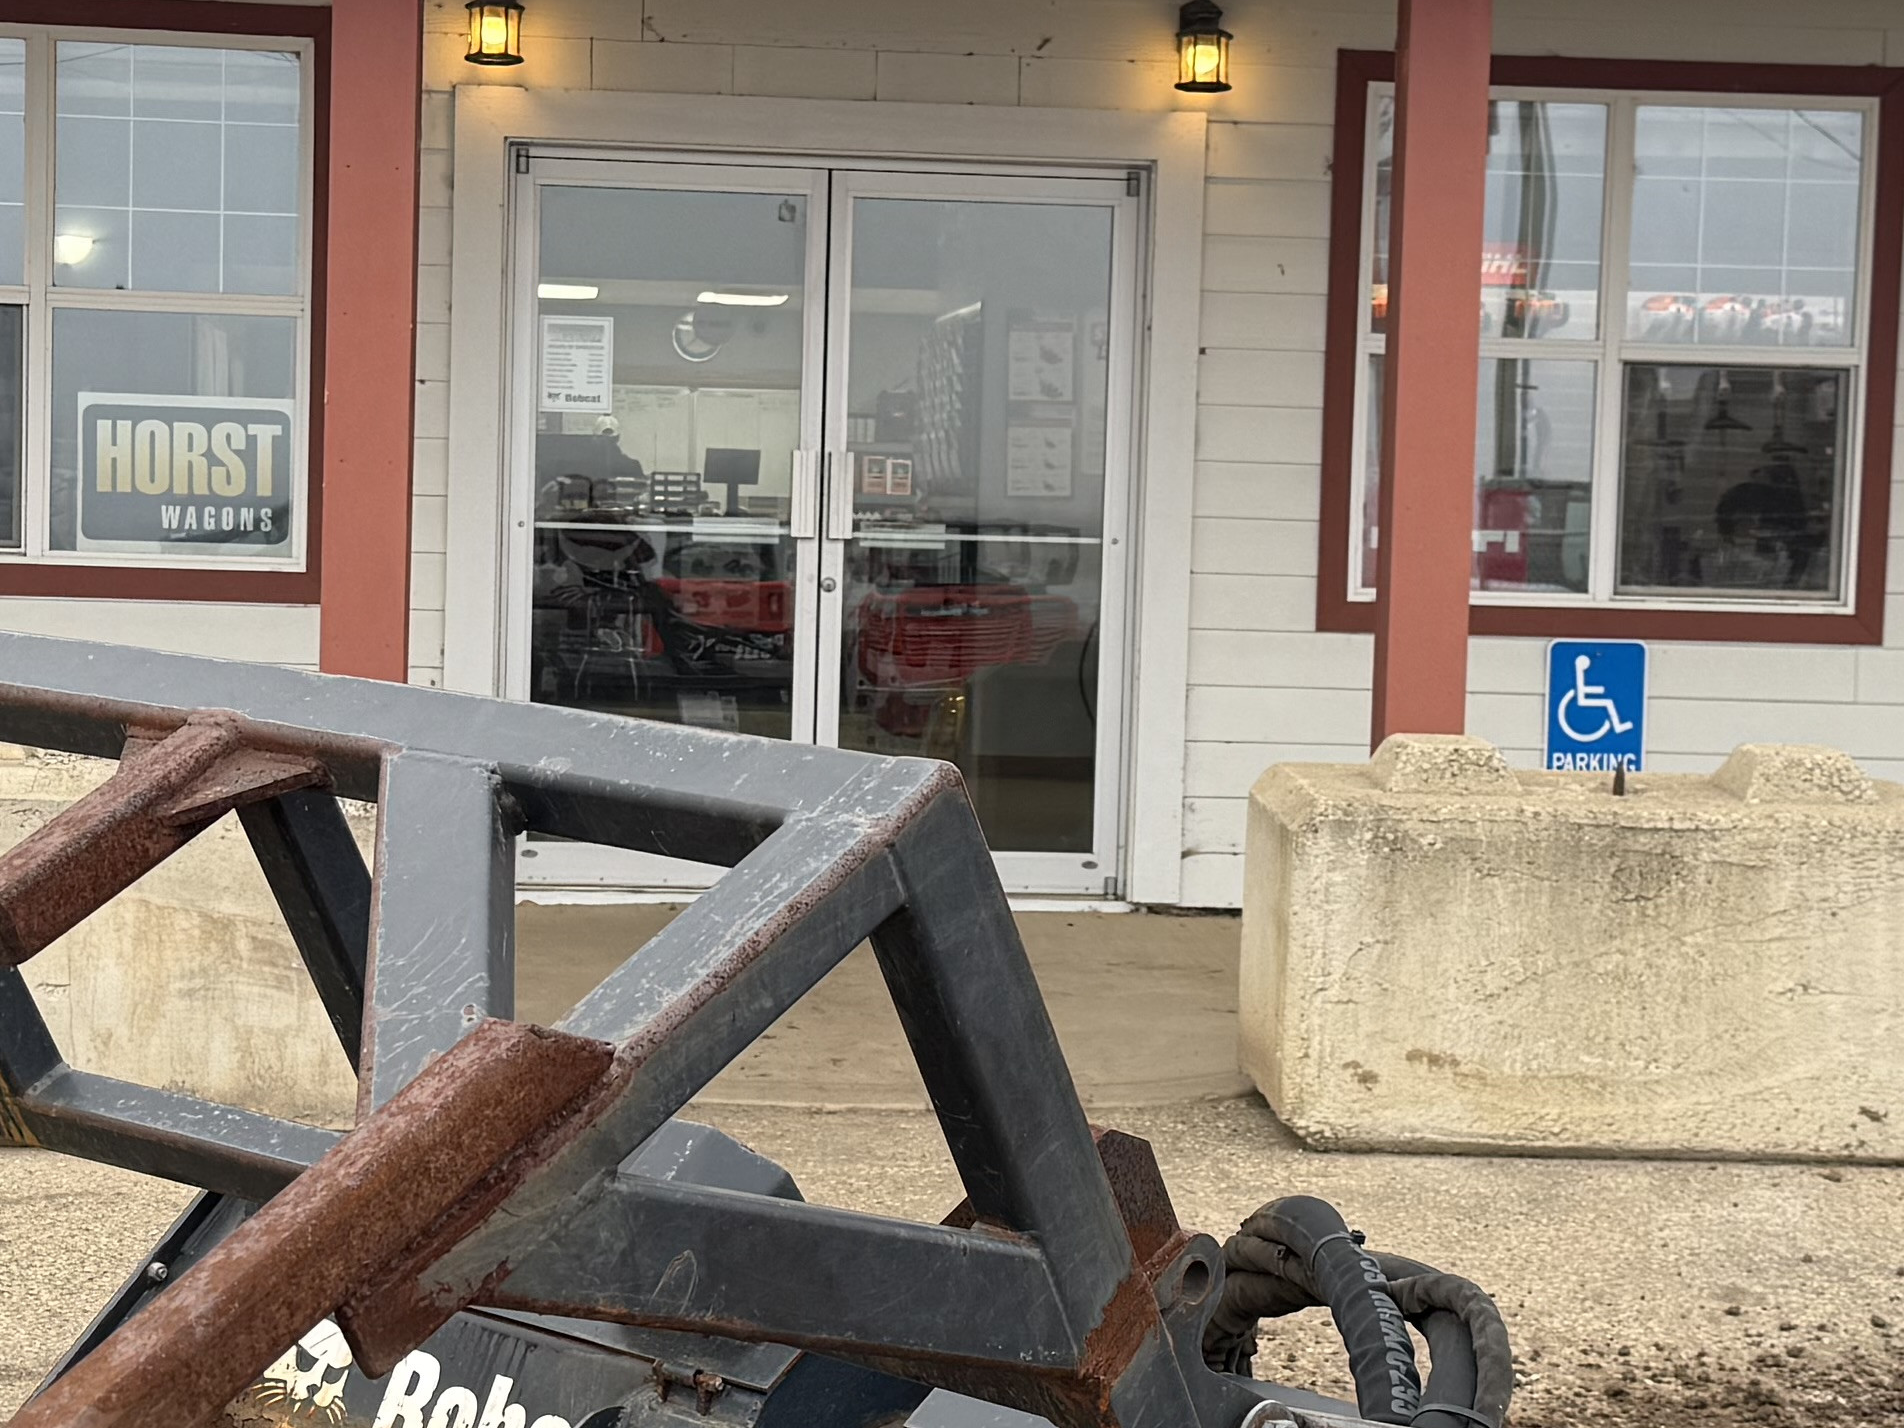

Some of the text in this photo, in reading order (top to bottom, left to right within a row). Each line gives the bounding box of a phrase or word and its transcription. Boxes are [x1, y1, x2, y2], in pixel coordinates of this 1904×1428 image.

[96, 418, 283, 498] HORST
[160, 504, 273, 533] WAGONS
[1551, 752, 1637, 772] PARKING
